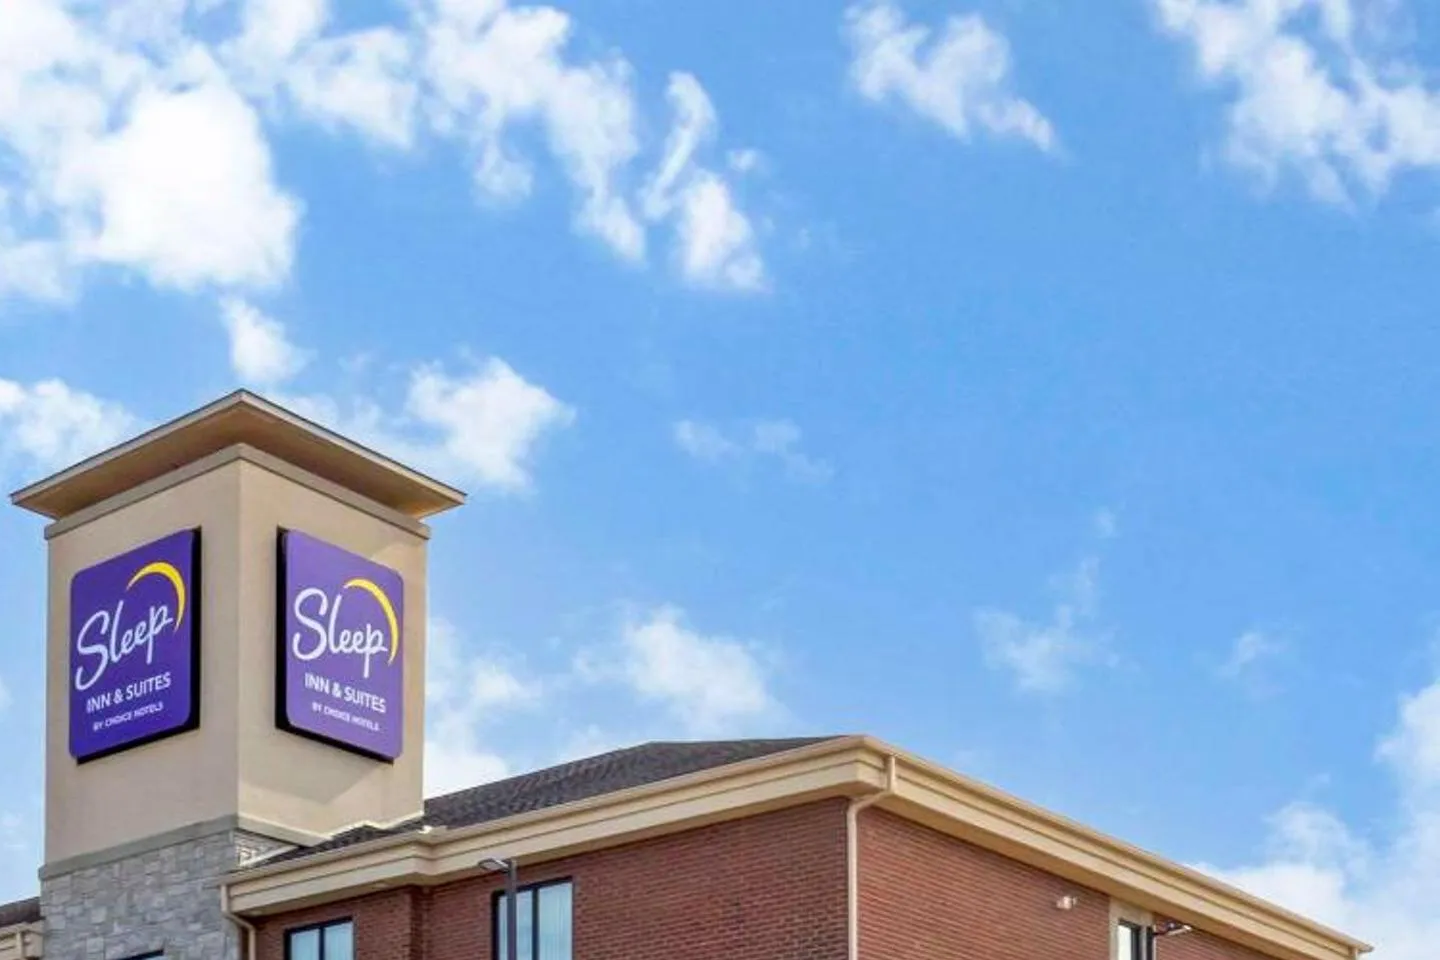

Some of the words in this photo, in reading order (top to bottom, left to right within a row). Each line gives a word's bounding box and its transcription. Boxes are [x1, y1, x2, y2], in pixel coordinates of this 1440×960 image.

[75, 600, 173, 690] Sleep
[292, 587, 388, 678] Sleep
[86, 692, 111, 713] INN
[113, 688, 123, 704] &
[125, 671, 171, 700] SUITES
[304, 672, 330, 694] INN
[332, 682, 342, 698] &
[343, 686, 386, 713] SUITES
